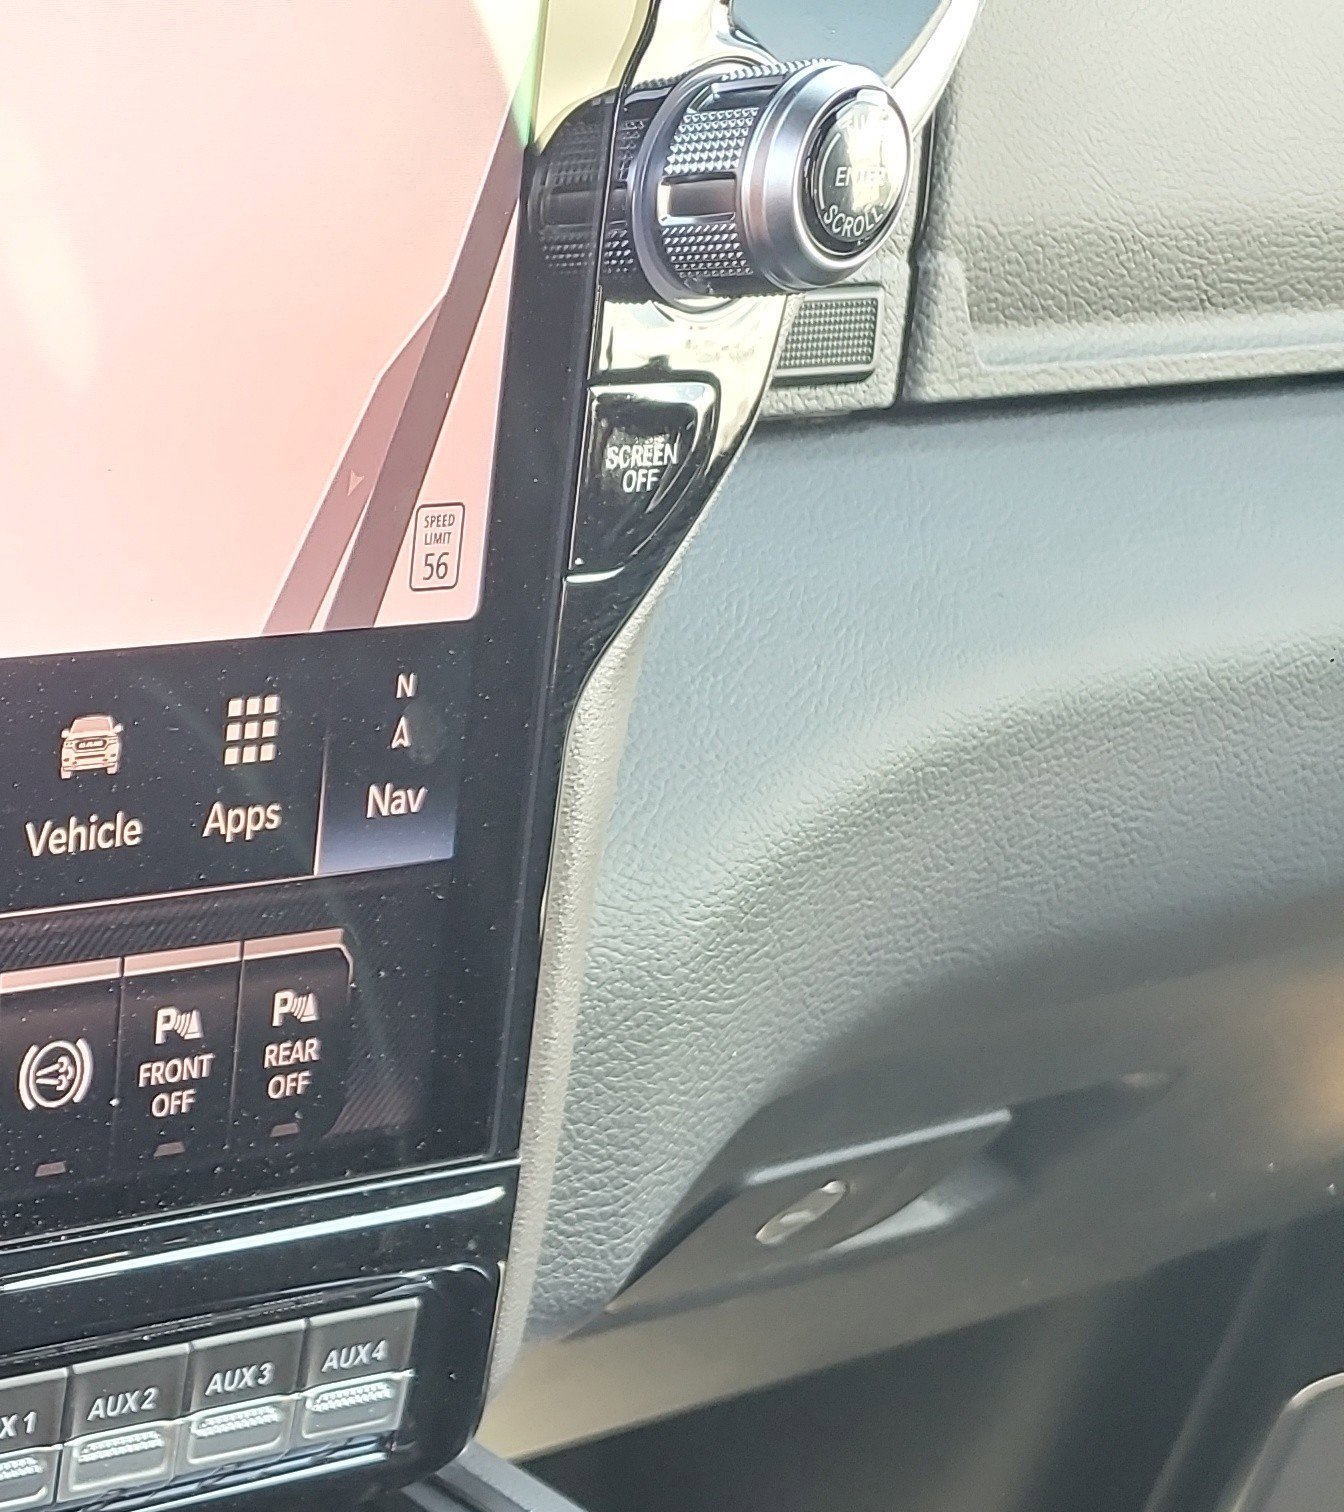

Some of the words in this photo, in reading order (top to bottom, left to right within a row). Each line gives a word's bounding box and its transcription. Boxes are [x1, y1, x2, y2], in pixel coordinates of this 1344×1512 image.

[823, 204, 883, 237] SCROLL
[605, 442, 679, 469] SCREEN
[623, 469, 660, 493] OFF
[424, 513, 456, 528] SPEED
[424, 532, 452, 545] LIMIT
[423, 551, 450, 581] 56
[396, 674, 416, 698] N
[366, 782, 426, 819] Nav
[26, 811, 143, 857] Vehicle
[202, 800, 282, 843] Apps
[264, 1039, 320, 1068] REAR
[139, 1054, 214, 1088] FRONT
[268, 1071, 312, 1099] OFF
[152, 1090, 195, 1118] OFF
[322, 1348, 370, 1372] AUX
[371, 1340, 389, 1362] 4
[205, 1370, 253, 1396] AUX
[255, 1363, 275, 1385] 3
[87, 1395, 134, 1421] AUX
[136, 1388, 159, 1410] 2
[22, 1412, 38, 1434] 1
